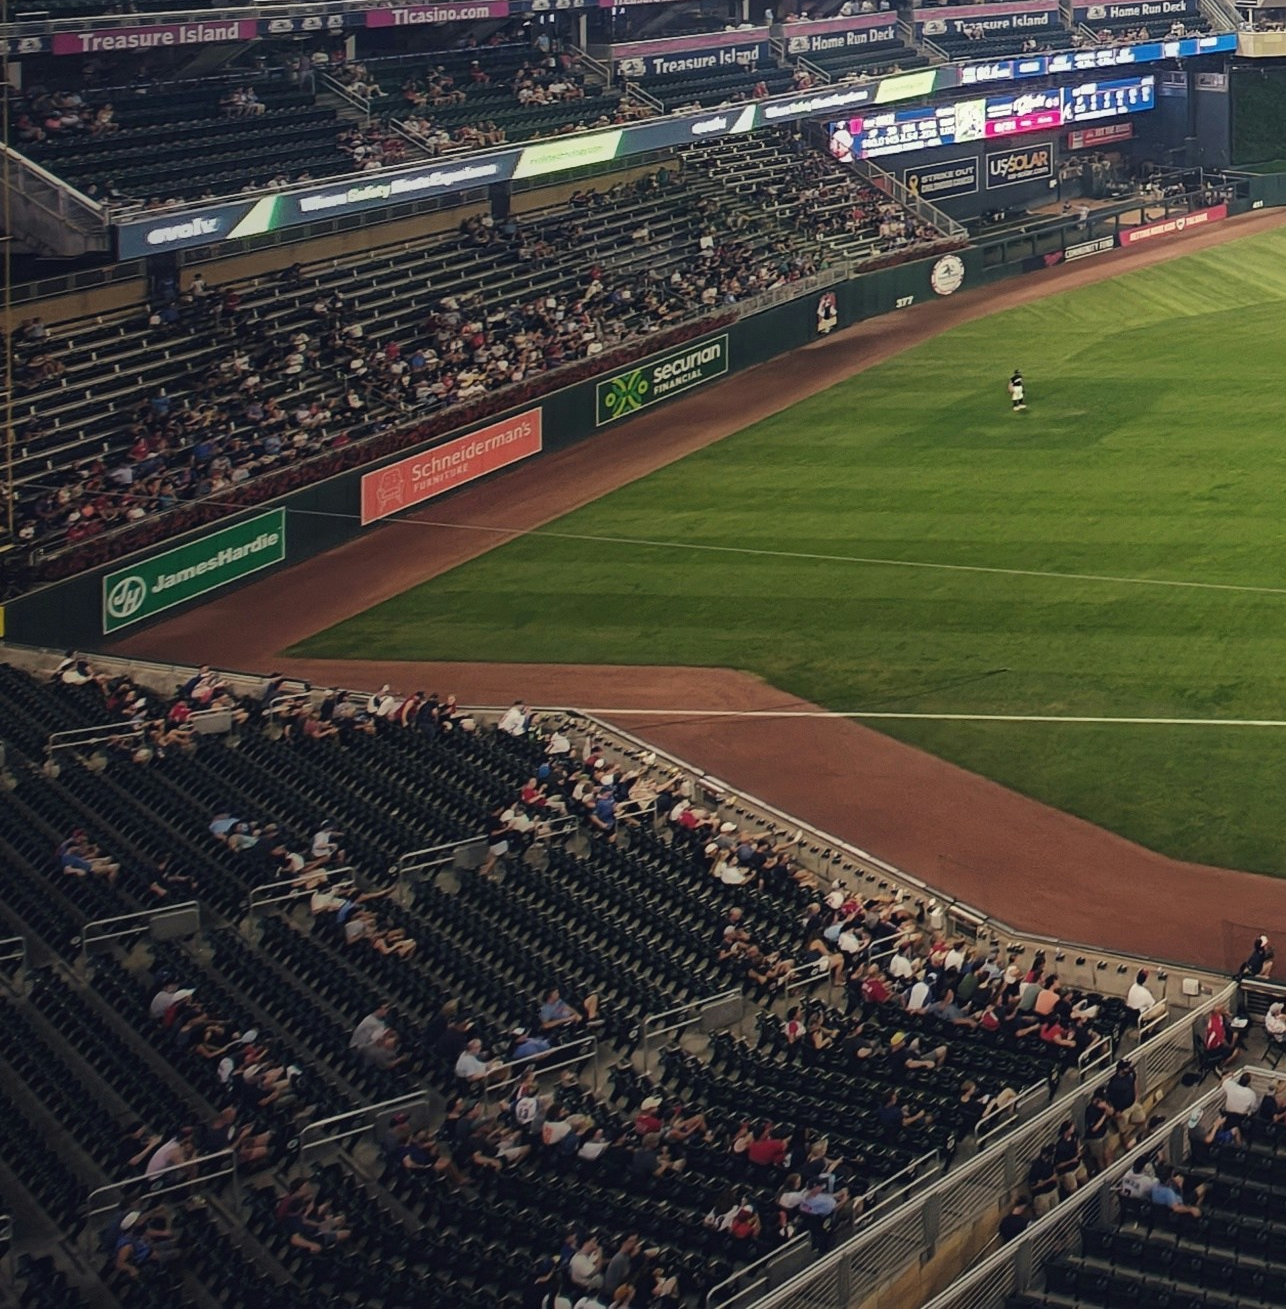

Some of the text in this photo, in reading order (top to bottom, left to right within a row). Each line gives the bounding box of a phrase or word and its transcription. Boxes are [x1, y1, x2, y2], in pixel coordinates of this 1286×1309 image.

[1012, 13, 1049, 29] Island
[1110, 0, 1188, 19] Home Run Deck
[78, 22, 239, 52] Treasure Island
[812, 26, 895, 52] Home Run Deck
[653, 53, 717, 75] Treasure
[920, 165, 975, 184] STRIKE OUT
[146, 215, 221, 246] evolv
[653, 344, 721, 384] securian
[654, 369, 702, 395] FINANCIAL
[411, 422, 532, 482] Schneiderman's
[413, 463, 470, 492] FURNITURE
[151, 532, 279, 594] JamesHardie
